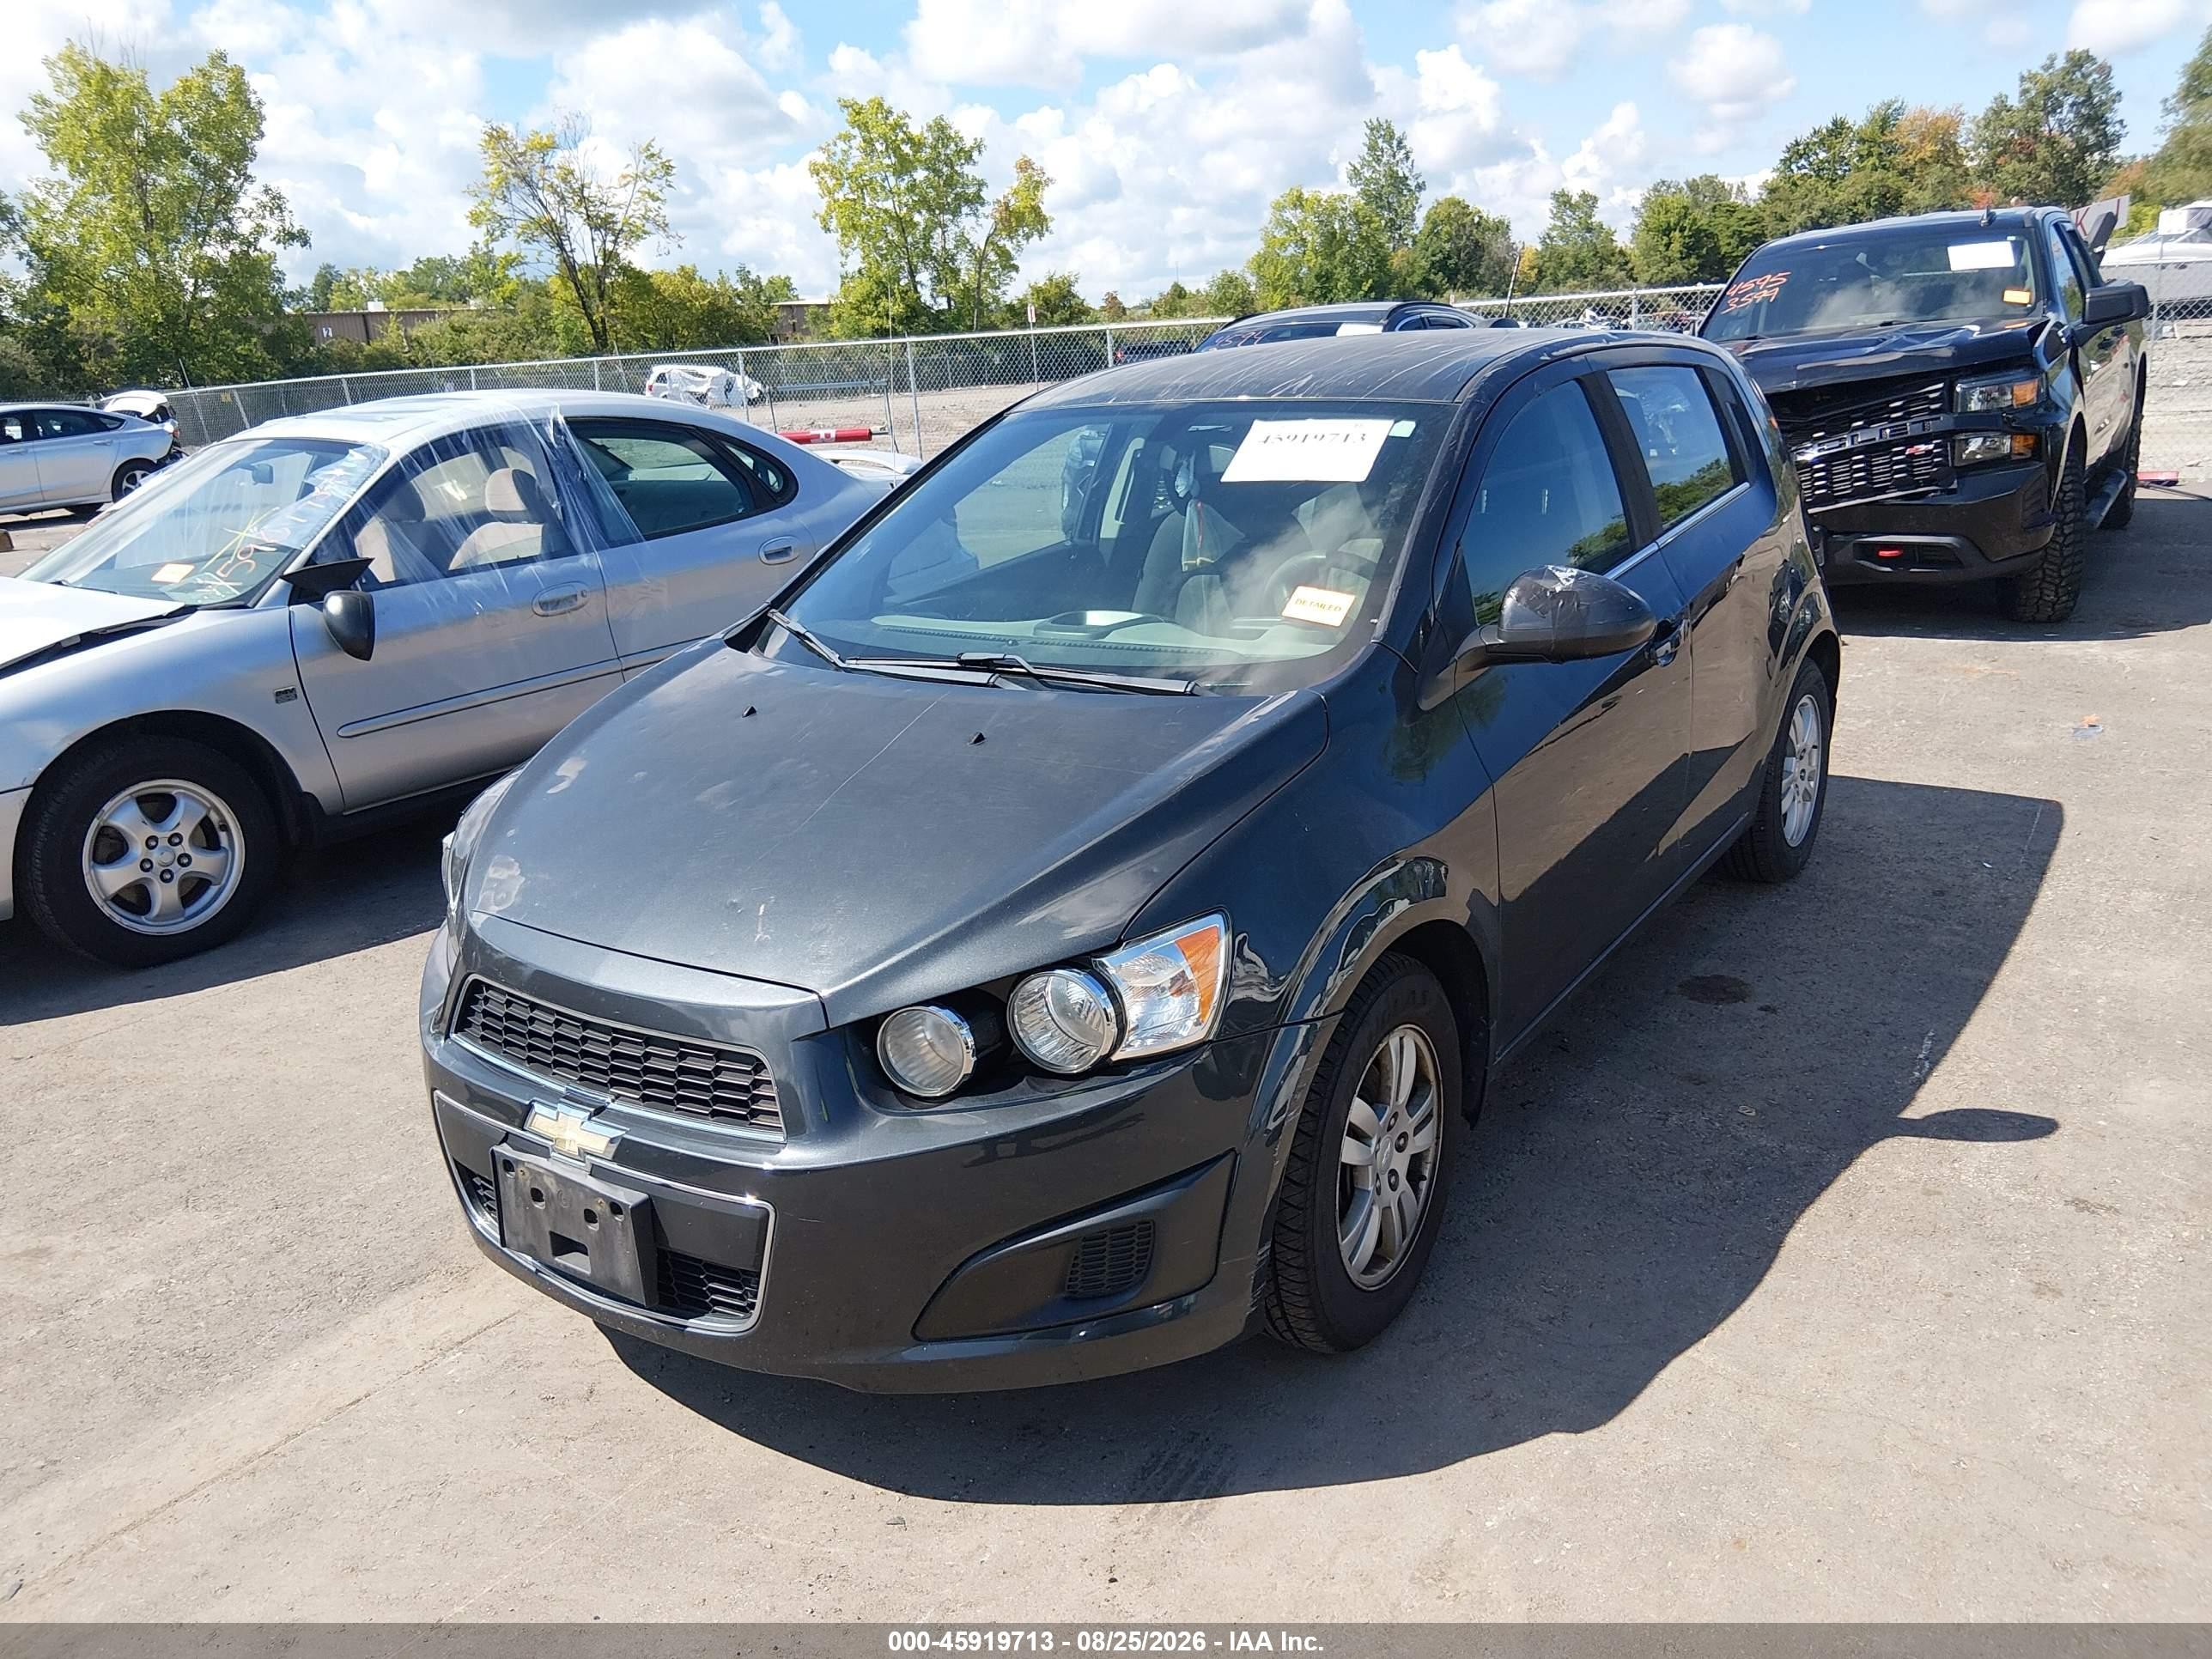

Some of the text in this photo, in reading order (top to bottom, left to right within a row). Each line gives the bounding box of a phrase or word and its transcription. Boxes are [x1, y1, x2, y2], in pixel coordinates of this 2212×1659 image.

[1726, 271, 1792, 296] 4595
[1720, 287, 1780, 315] 3599
[1258, 433, 1367, 447] 45919713
[1295, 597, 1342, 613] DETAILED
